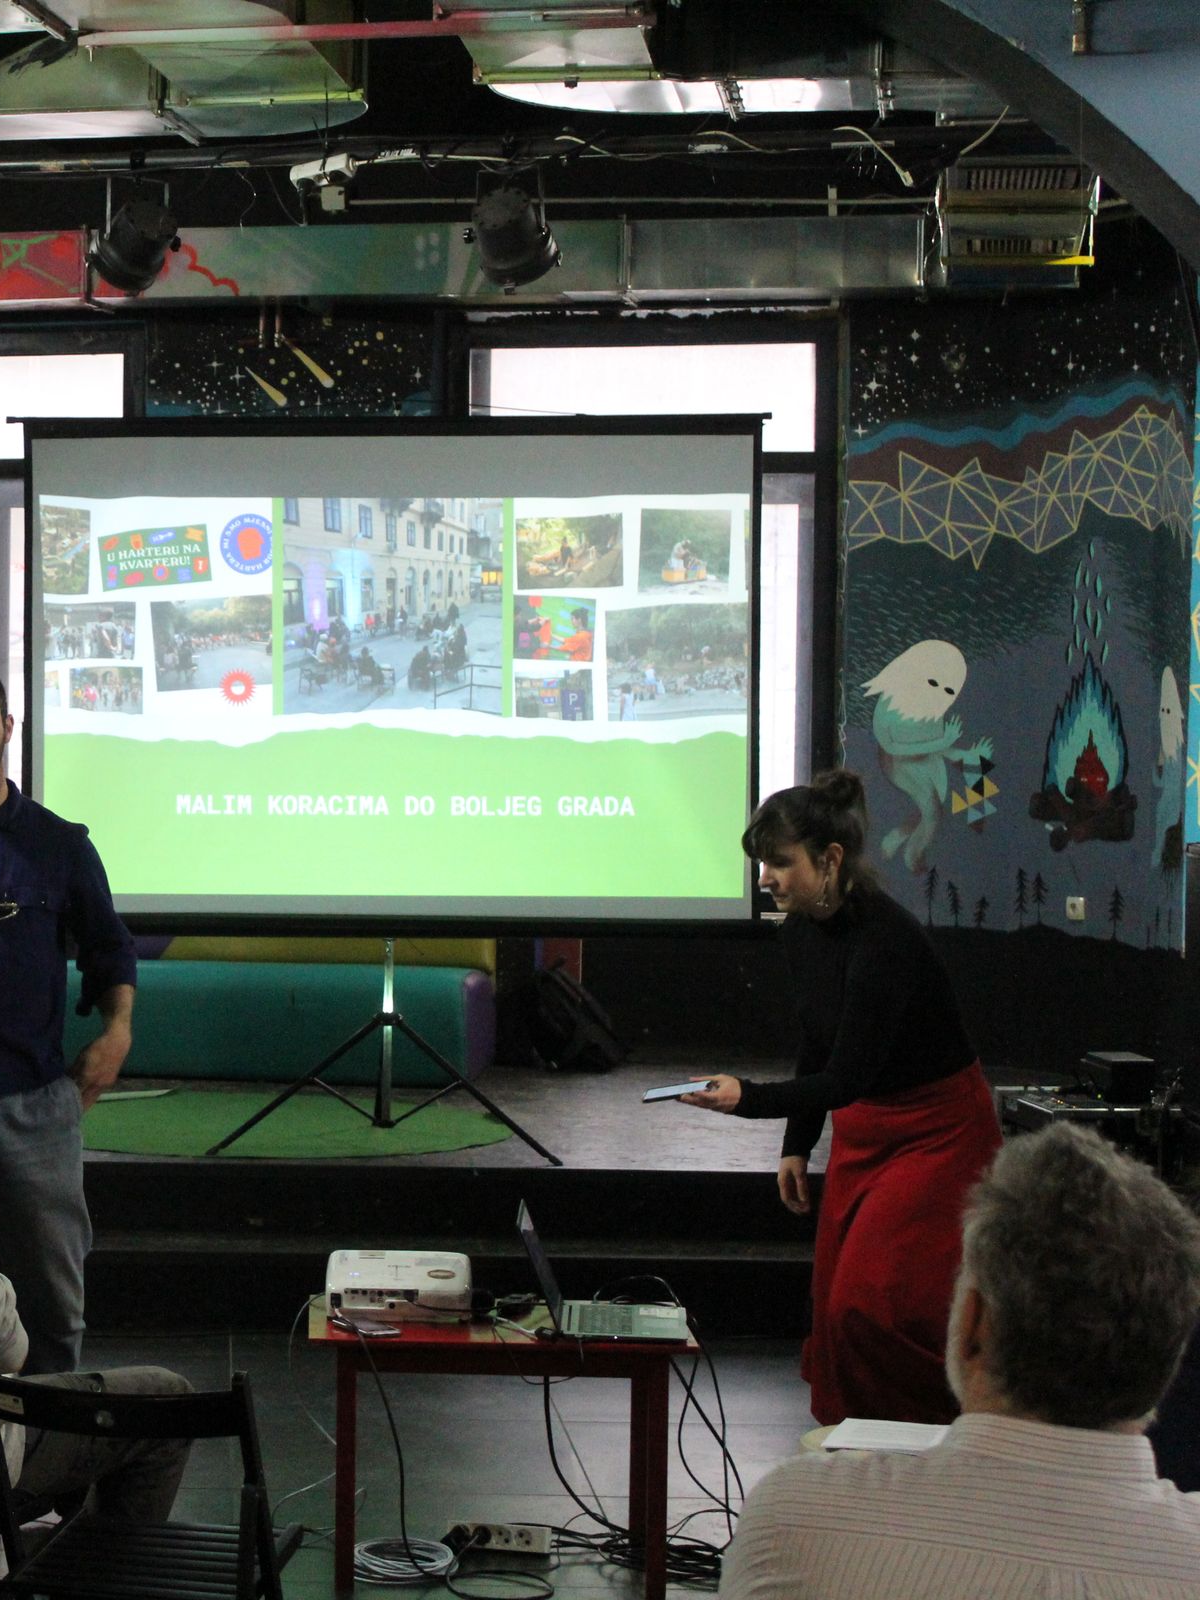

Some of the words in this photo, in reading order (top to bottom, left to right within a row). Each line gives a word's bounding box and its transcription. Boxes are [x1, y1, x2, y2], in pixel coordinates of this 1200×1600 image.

[107, 553, 115, 562] U
[119, 545, 179, 560] HARTERU
[182, 543, 201, 554] NA
[119, 555, 191, 571] KVARTERU!
[569, 692, 578, 705] P
[176, 794, 252, 816] MALIM
[267, 794, 389, 816] KORACIMA
[404, 795, 435, 816] DO
[451, 795, 542, 816] BOLJEG
[557, 795, 636, 817] GRADA
